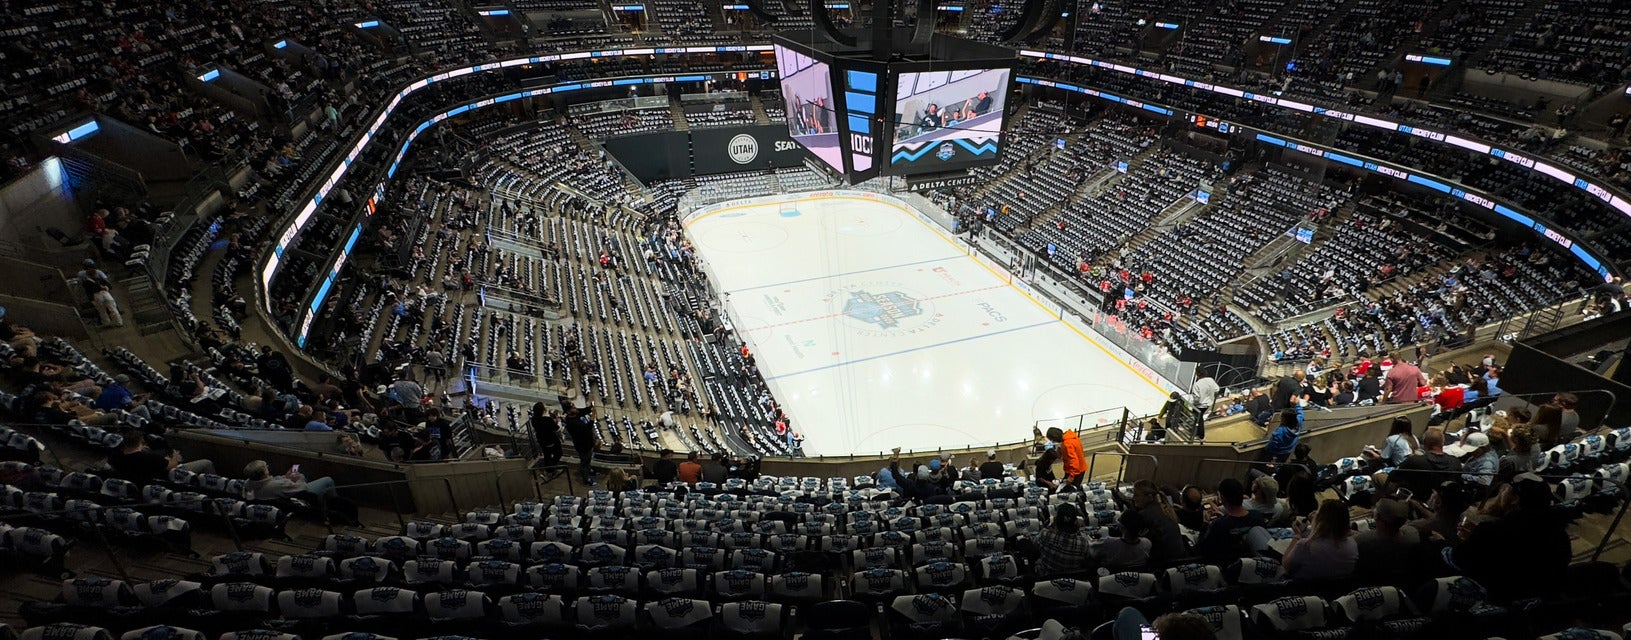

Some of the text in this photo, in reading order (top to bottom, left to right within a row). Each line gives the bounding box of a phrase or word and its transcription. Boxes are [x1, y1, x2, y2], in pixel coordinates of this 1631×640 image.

[1399, 125, 1445, 141] UTAH HOCKEY CLUB
[733, 144, 753, 155] UTAH
[775, 141, 801, 152] SEAT
[1297, 144, 1312, 154] HOCKEY
[1312, 148, 1324, 157] CLUB
[1491, 148, 1535, 168] UTAH HOCKEY CLUB
[1364, 162, 1408, 180] UTAH HOCKEY CLUB
[920, 178, 976, 190] DELTA CENTER
[1452, 188, 1495, 210] UTAH HOCKEY CLUB
[976, 302, 1007, 322] PACS
[418, 561, 440, 569] GAME
[229, 583, 256, 593] GAME
[1355, 587, 1381, 600] GAME
[296, 590, 321, 600] GAME
[440, 591, 466, 600] GAME
[594, 603, 618, 612] GAME
[741, 602, 764, 611] GAME
[1278, 598, 1306, 611] GAME
